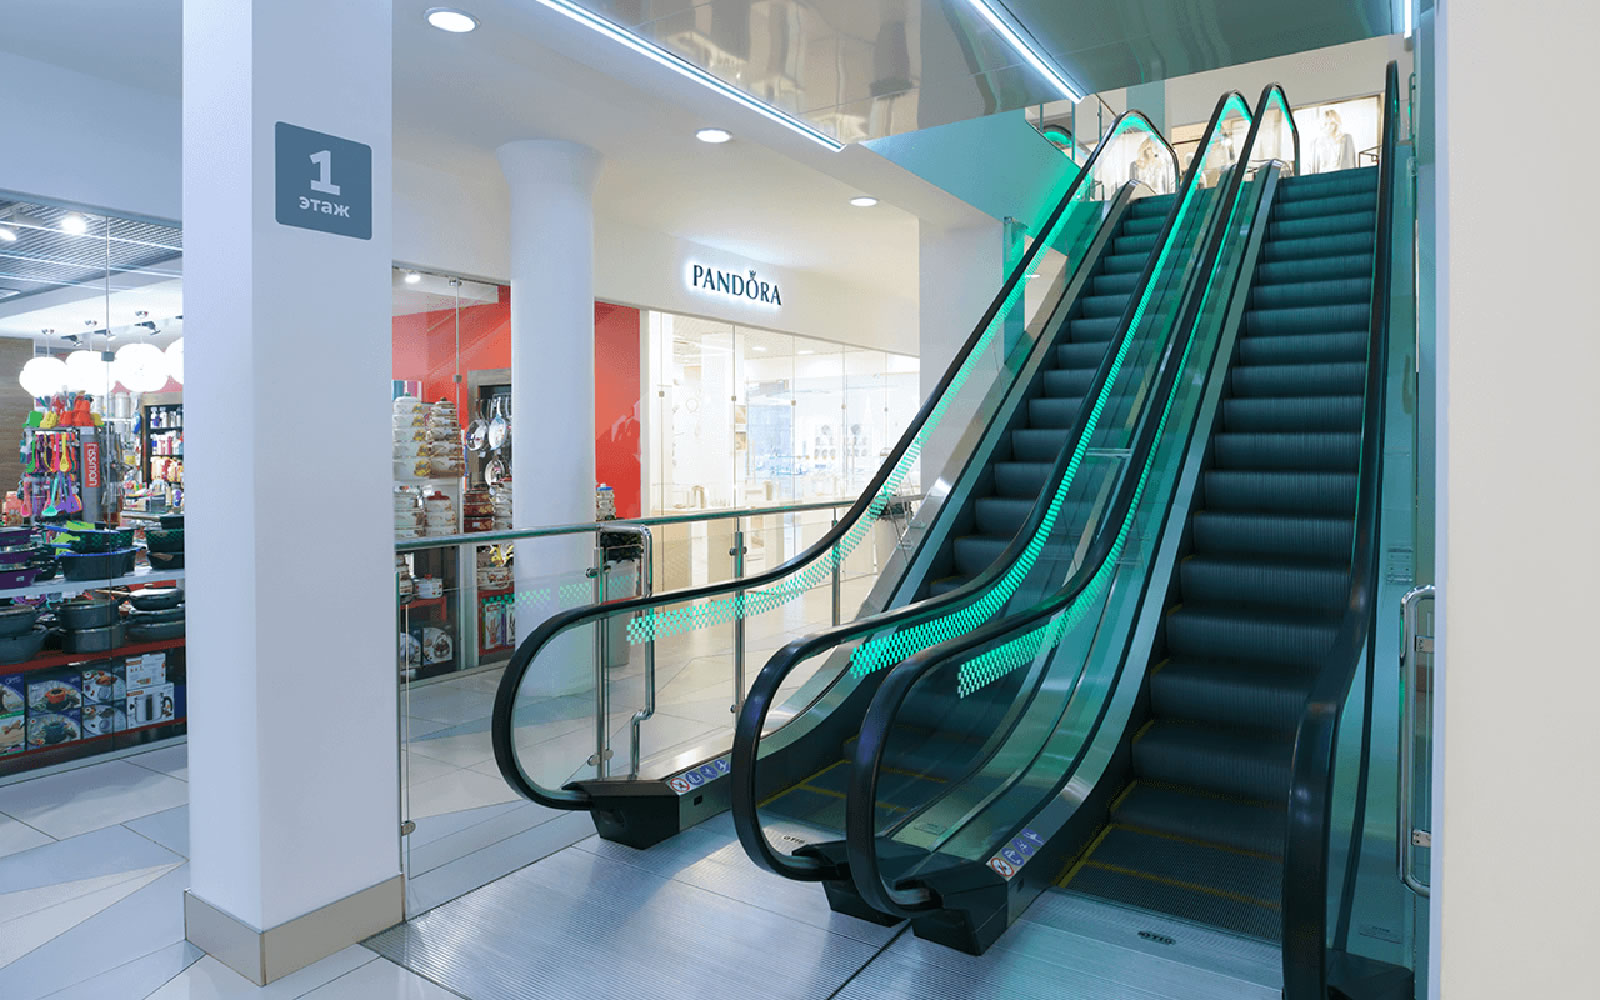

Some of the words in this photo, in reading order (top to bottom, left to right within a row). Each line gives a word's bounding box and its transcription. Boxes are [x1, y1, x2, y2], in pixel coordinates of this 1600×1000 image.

[309, 150, 341, 196] 1
[299, 196, 351, 218] этаж
[693, 264, 782, 306] PANDORA
